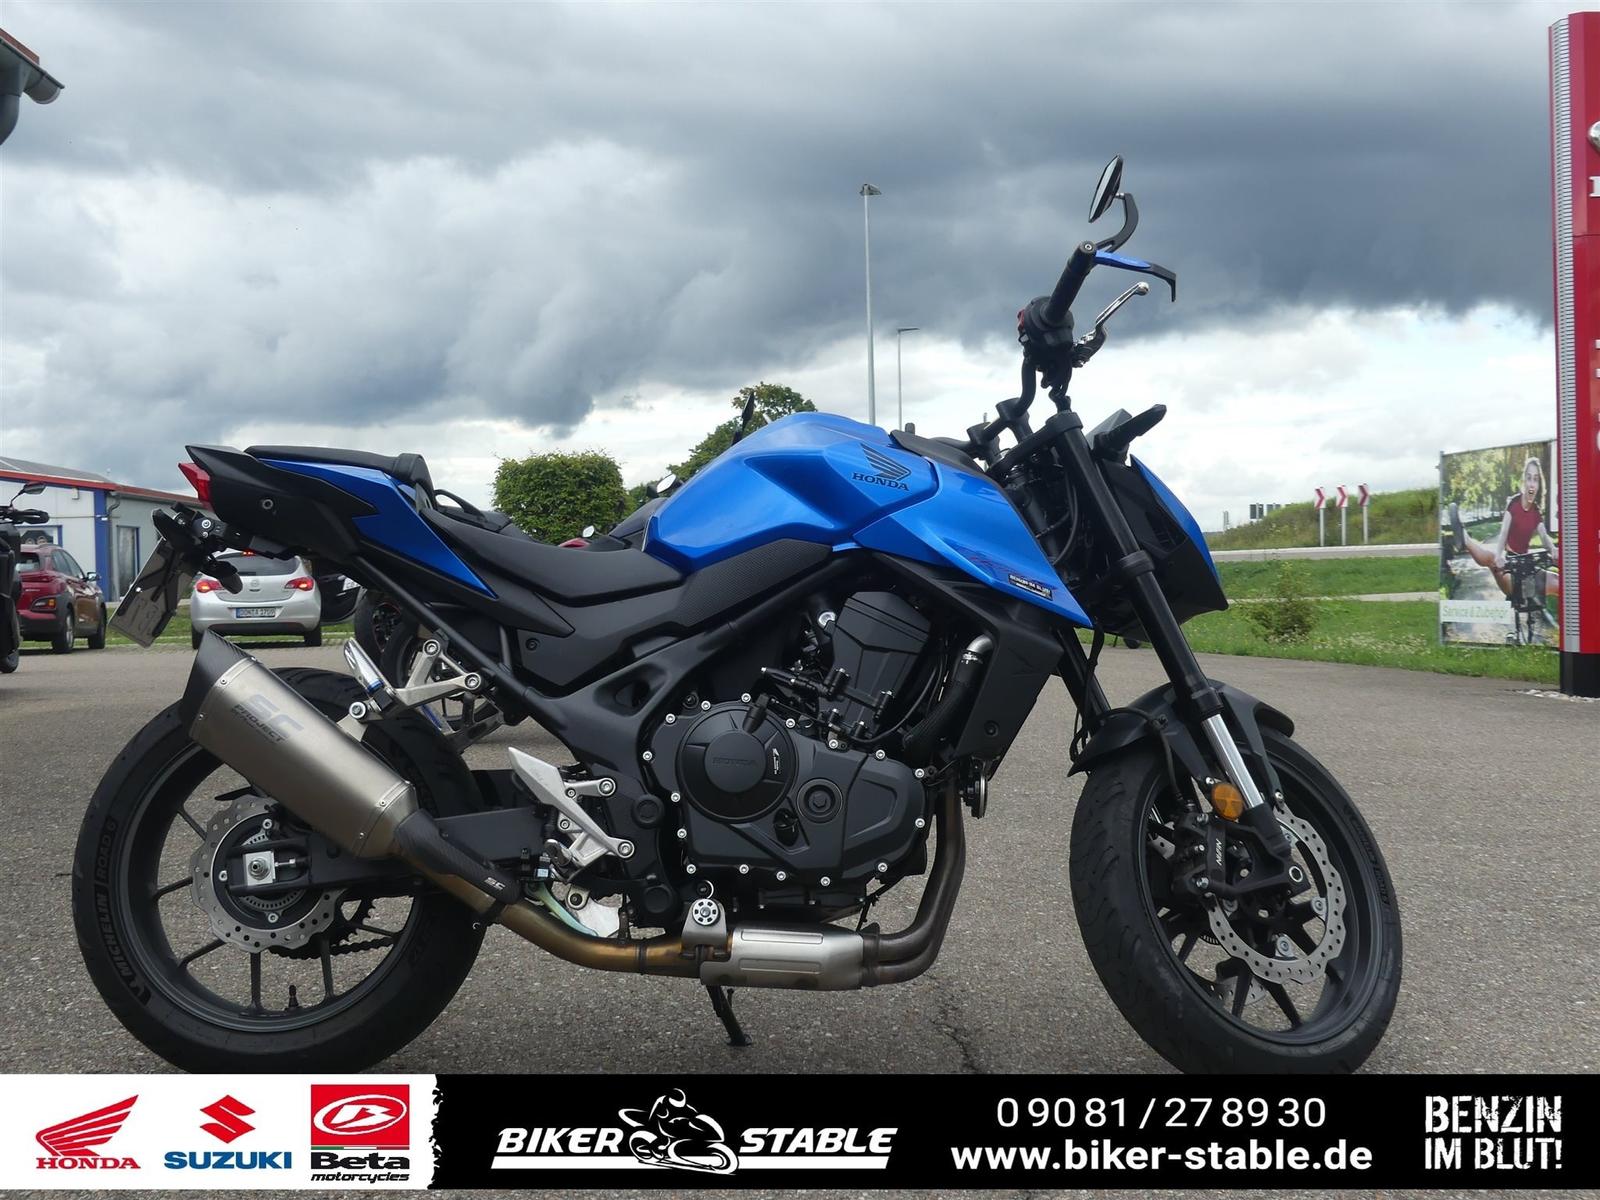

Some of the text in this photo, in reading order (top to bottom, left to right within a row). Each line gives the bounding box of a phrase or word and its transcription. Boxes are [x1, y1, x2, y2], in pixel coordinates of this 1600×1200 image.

[852, 472, 910, 491] HONDA
[233, 703, 286, 743] PROJECT
[96, 833, 113, 880] ROAD
[96, 893, 133, 979] MICHELIN
